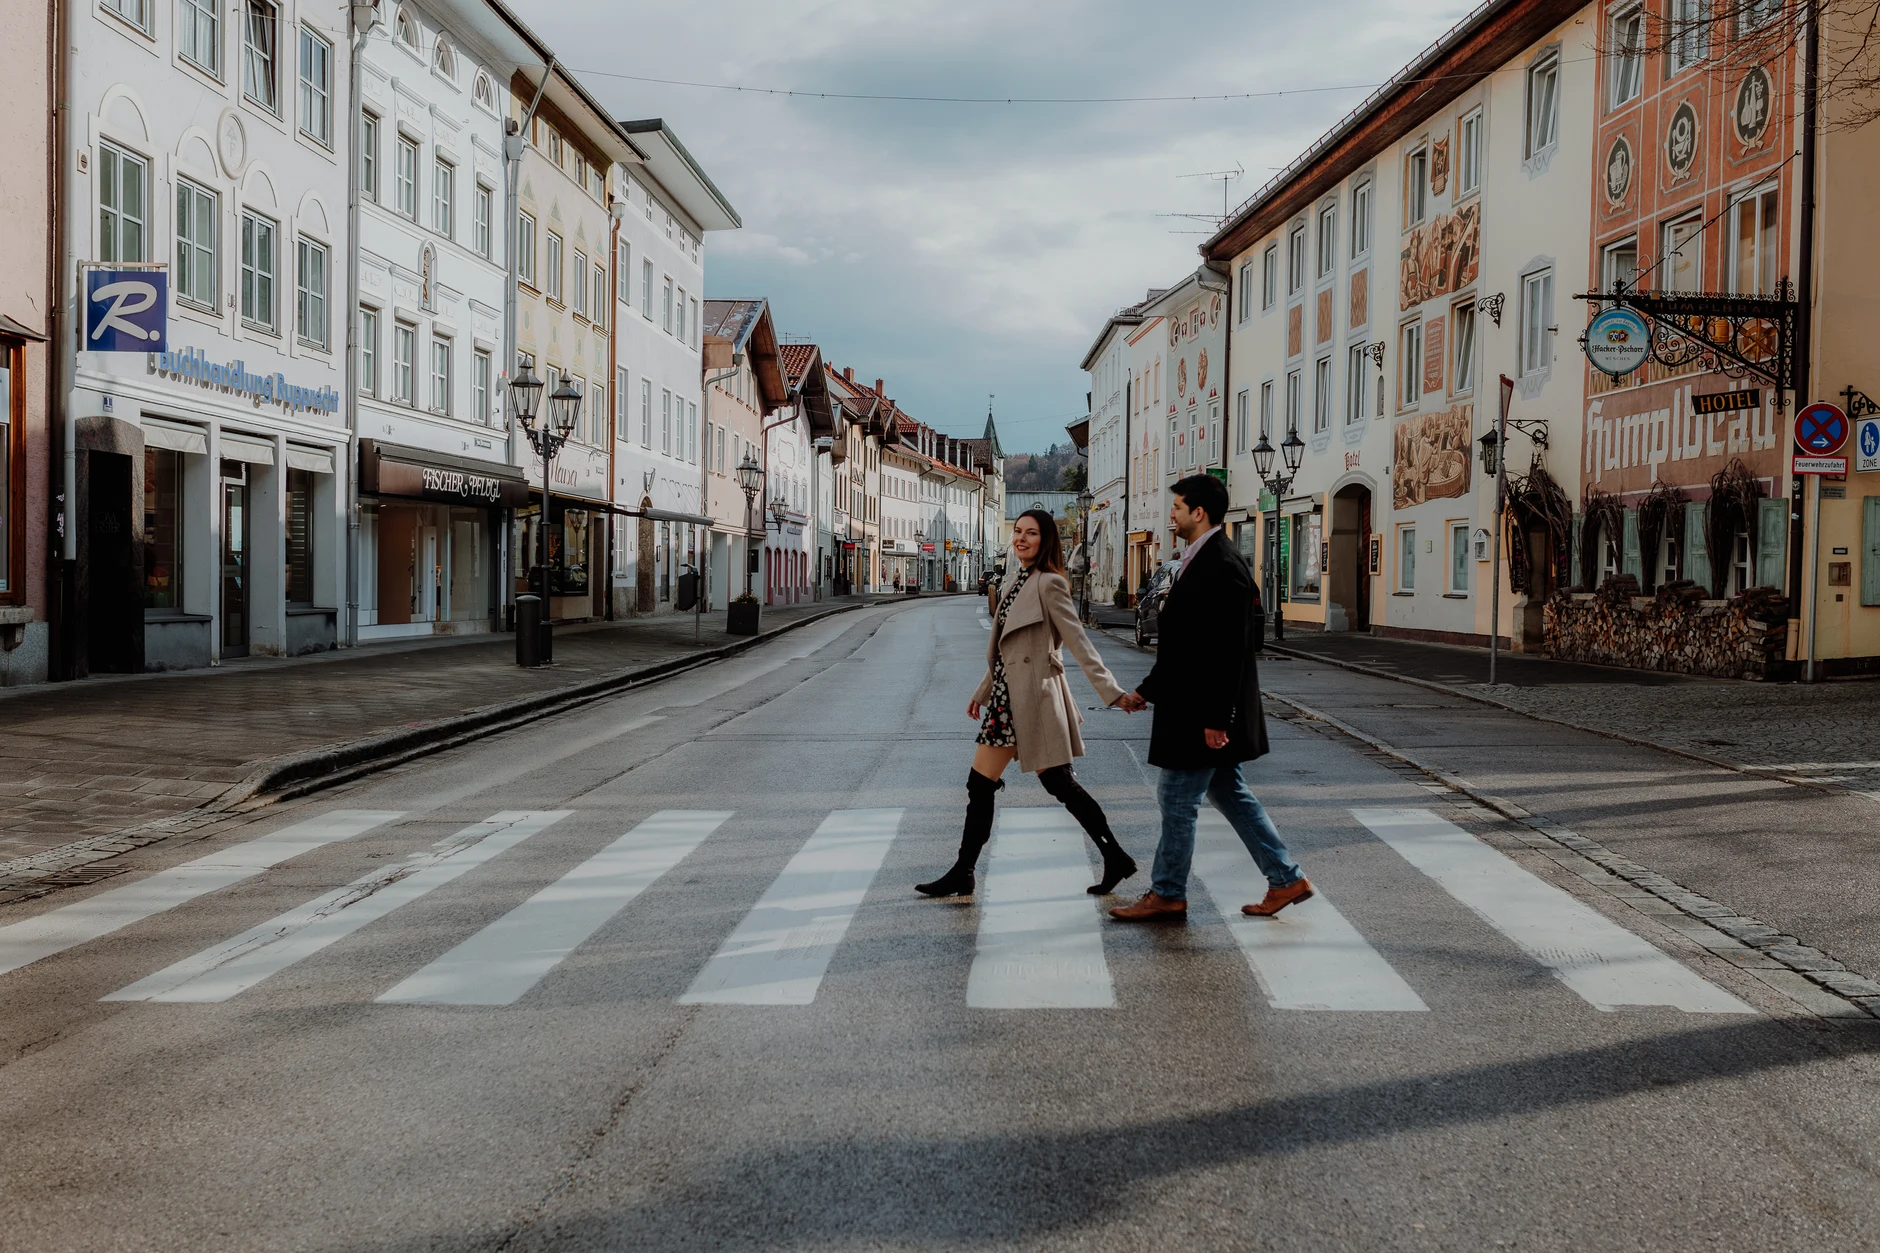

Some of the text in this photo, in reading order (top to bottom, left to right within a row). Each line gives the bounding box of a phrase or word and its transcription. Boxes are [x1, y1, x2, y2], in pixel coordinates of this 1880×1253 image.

[1591, 344, 1644, 354] Hacker-Pschorr
[160, 341, 339, 413] Buchhandlung Rupprecht
[1699, 391, 1756, 412] HOTEL
[1344, 450, 1361, 471] Hotel
[1796, 460, 1845, 469] Feuerwehrzufahrt
[1862, 459, 1878, 468] ZONE
